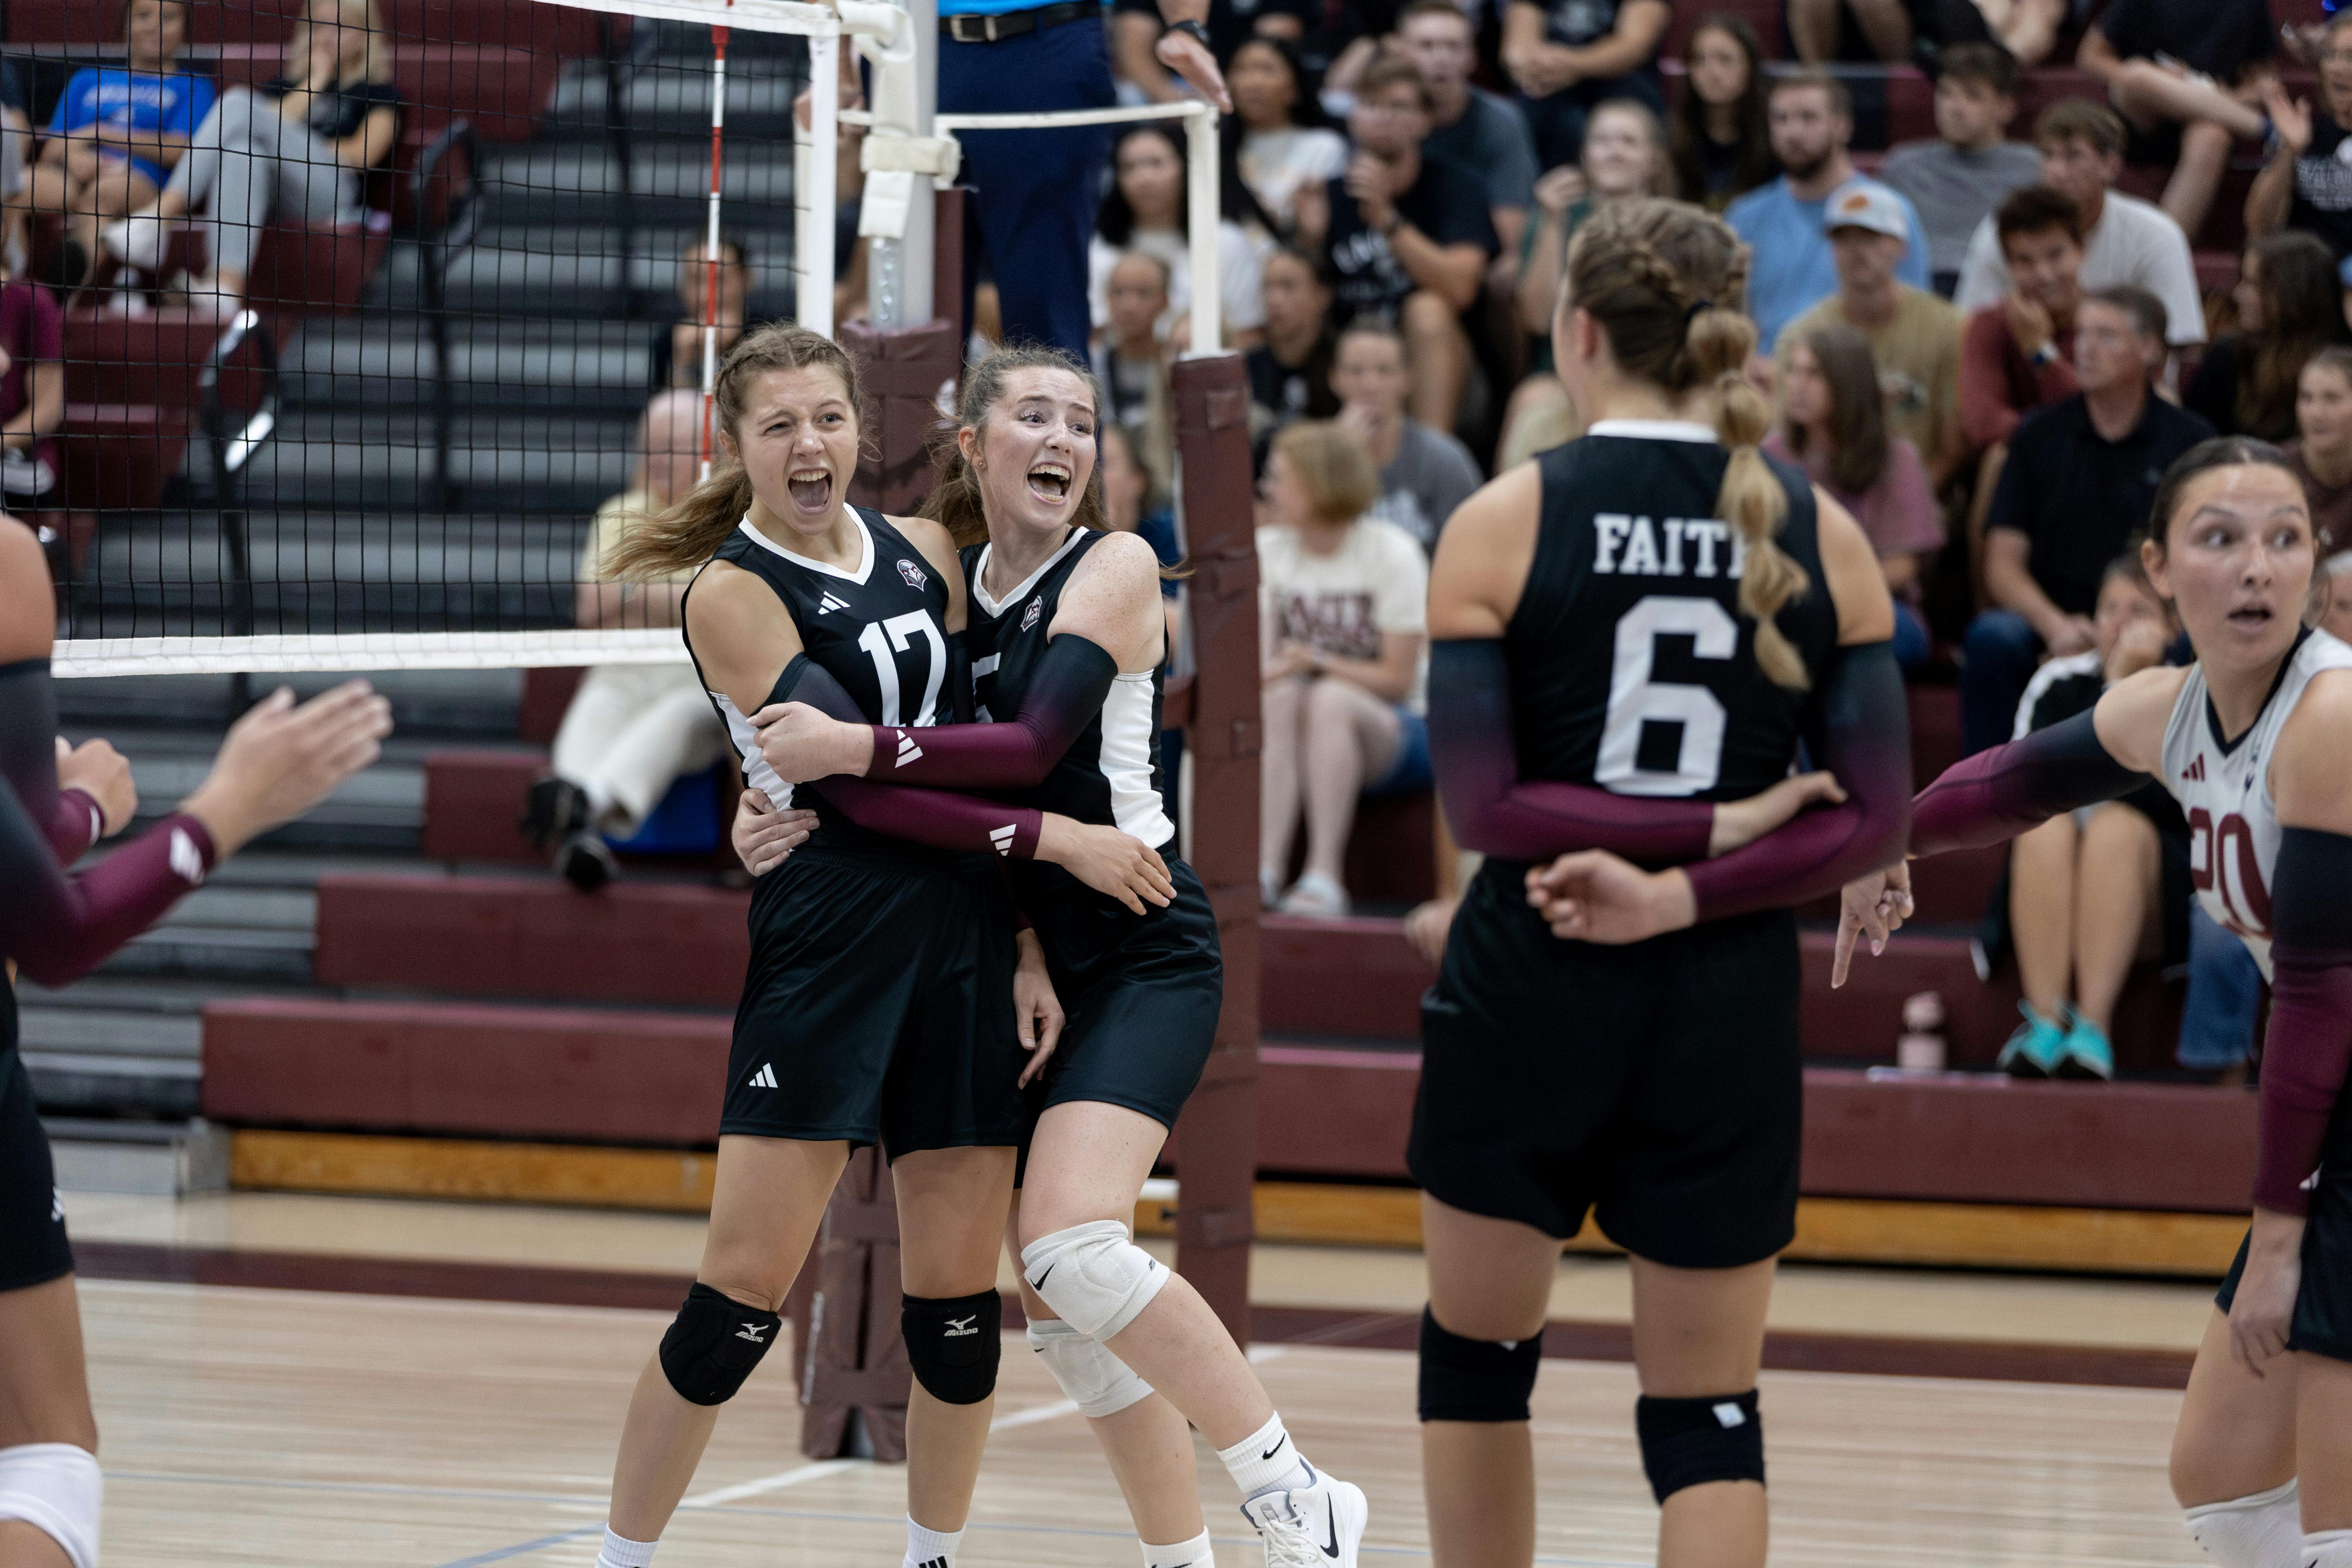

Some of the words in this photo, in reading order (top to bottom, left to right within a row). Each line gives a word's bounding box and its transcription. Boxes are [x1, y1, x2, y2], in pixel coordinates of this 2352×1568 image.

[858, 608, 946, 727] 17
[1593, 594, 1739, 797] 6
[944, 1327, 979, 1337] MIZUNO
